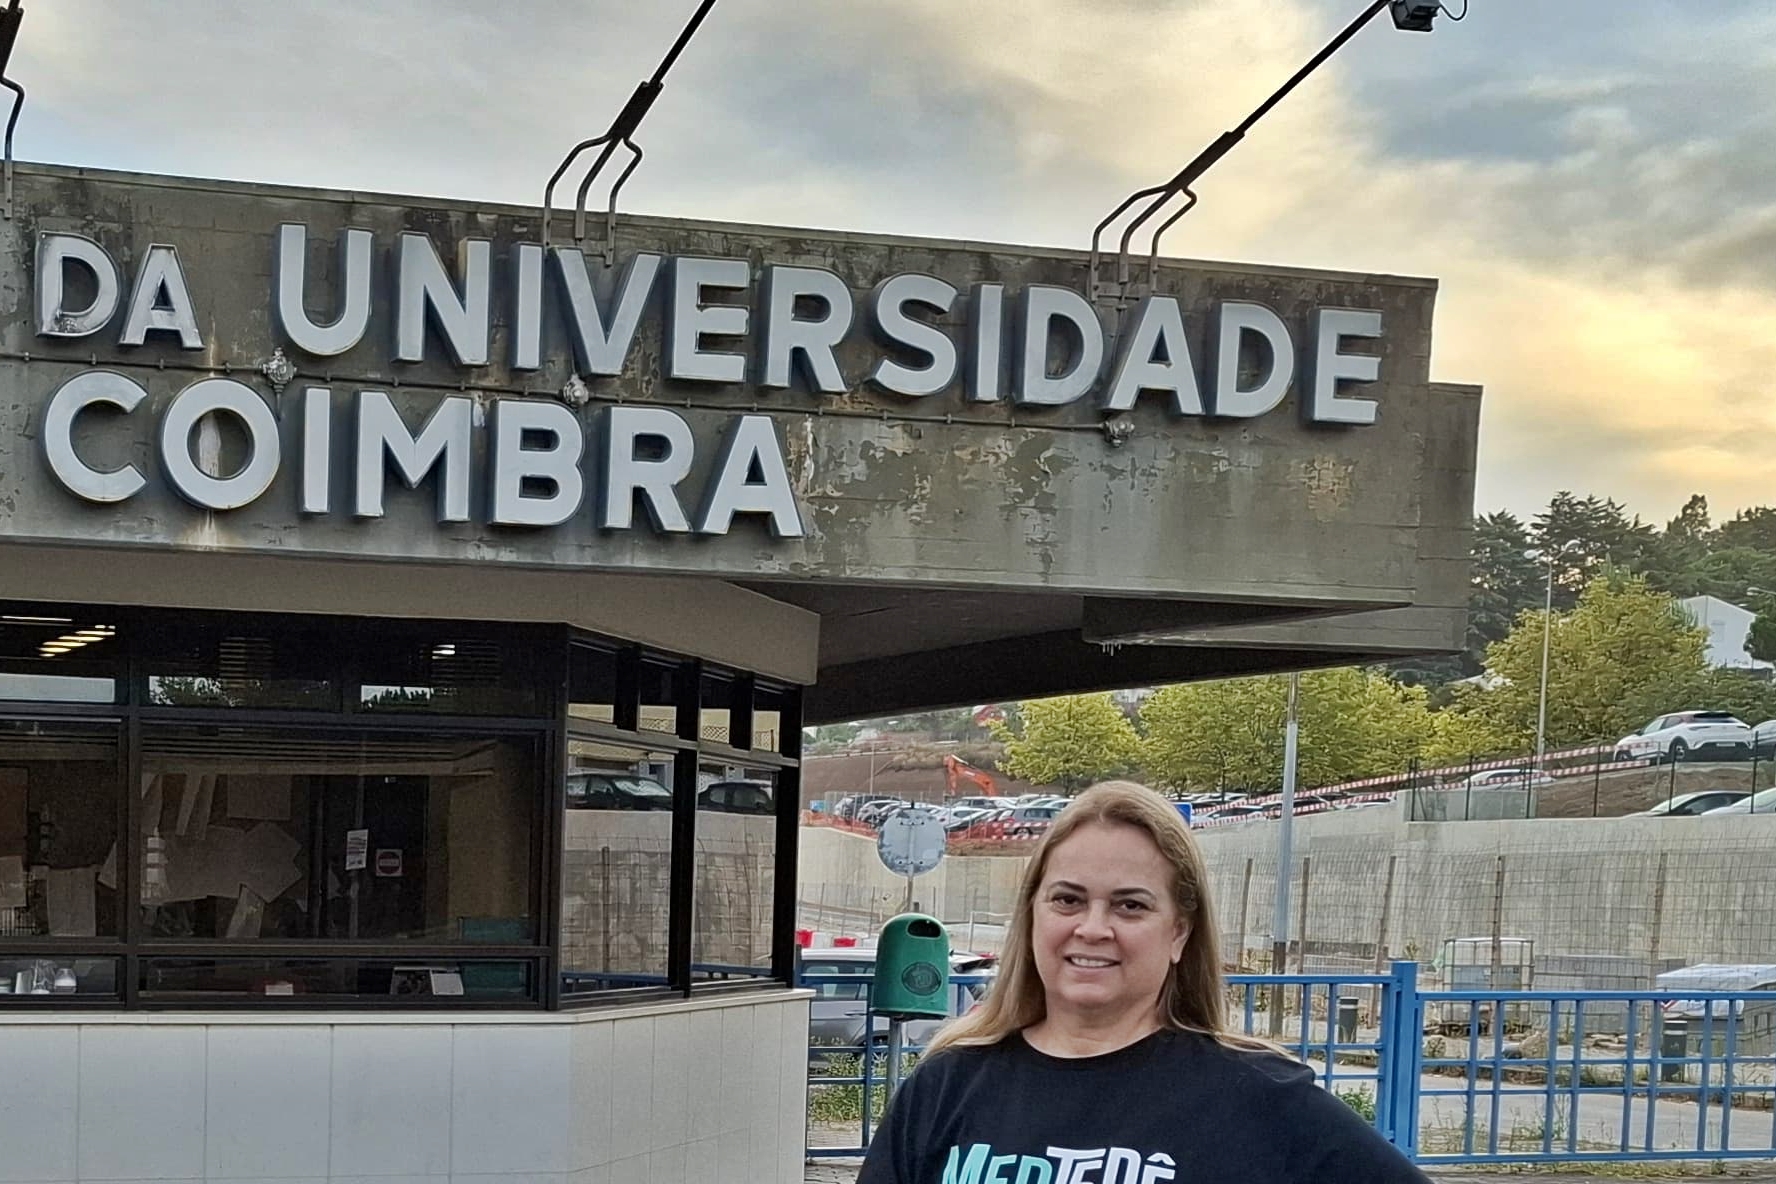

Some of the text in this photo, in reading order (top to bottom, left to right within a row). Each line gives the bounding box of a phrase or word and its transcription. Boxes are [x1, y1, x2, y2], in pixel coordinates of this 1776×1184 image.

[36, 231, 203, 351] DA
[274, 222, 1384, 428] UNIVERSIDADE
[41, 370, 805, 540] COIMBRA
